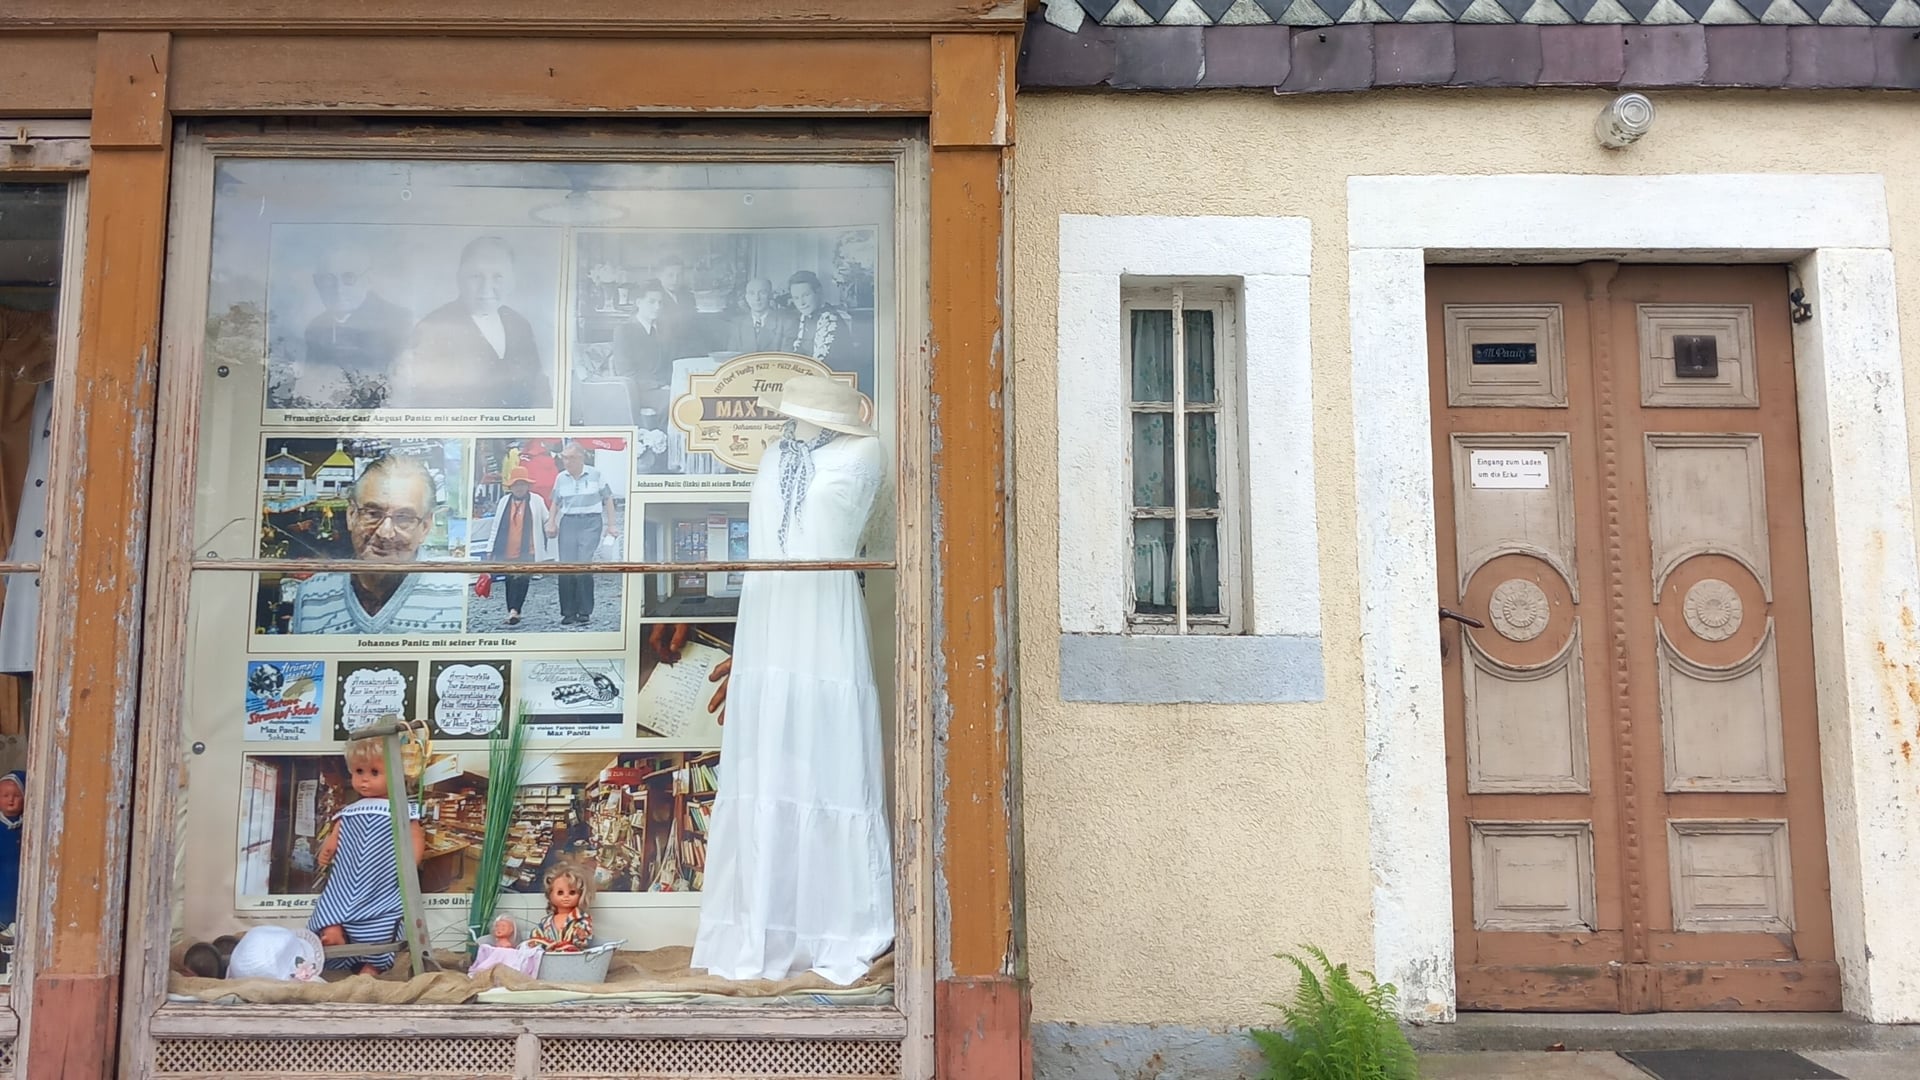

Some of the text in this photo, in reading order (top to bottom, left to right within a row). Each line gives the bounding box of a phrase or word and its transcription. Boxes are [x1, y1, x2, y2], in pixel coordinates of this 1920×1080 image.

[752, 379, 784, 392] Firm
[716, 400, 757, 417] MAX
[374, 414, 402, 423] August
[404, 414, 433, 422] Panitz
[434, 414, 449, 422] mit
[480, 414, 500, 422] Frau
[502, 414, 536, 422] Christel
[1477, 458, 1504, 466] Eingang
[637, 480, 663, 488] Johannes
[664, 480, 682, 488] Panitz
[732, 480, 751, 488] Bruder
[357, 638, 517, 648] Johannes Panitz mit seiner Frau Ilse
[260, 726, 277, 734] Max
[277, 898, 292, 907] Tag
[293, 898, 309, 906] der
